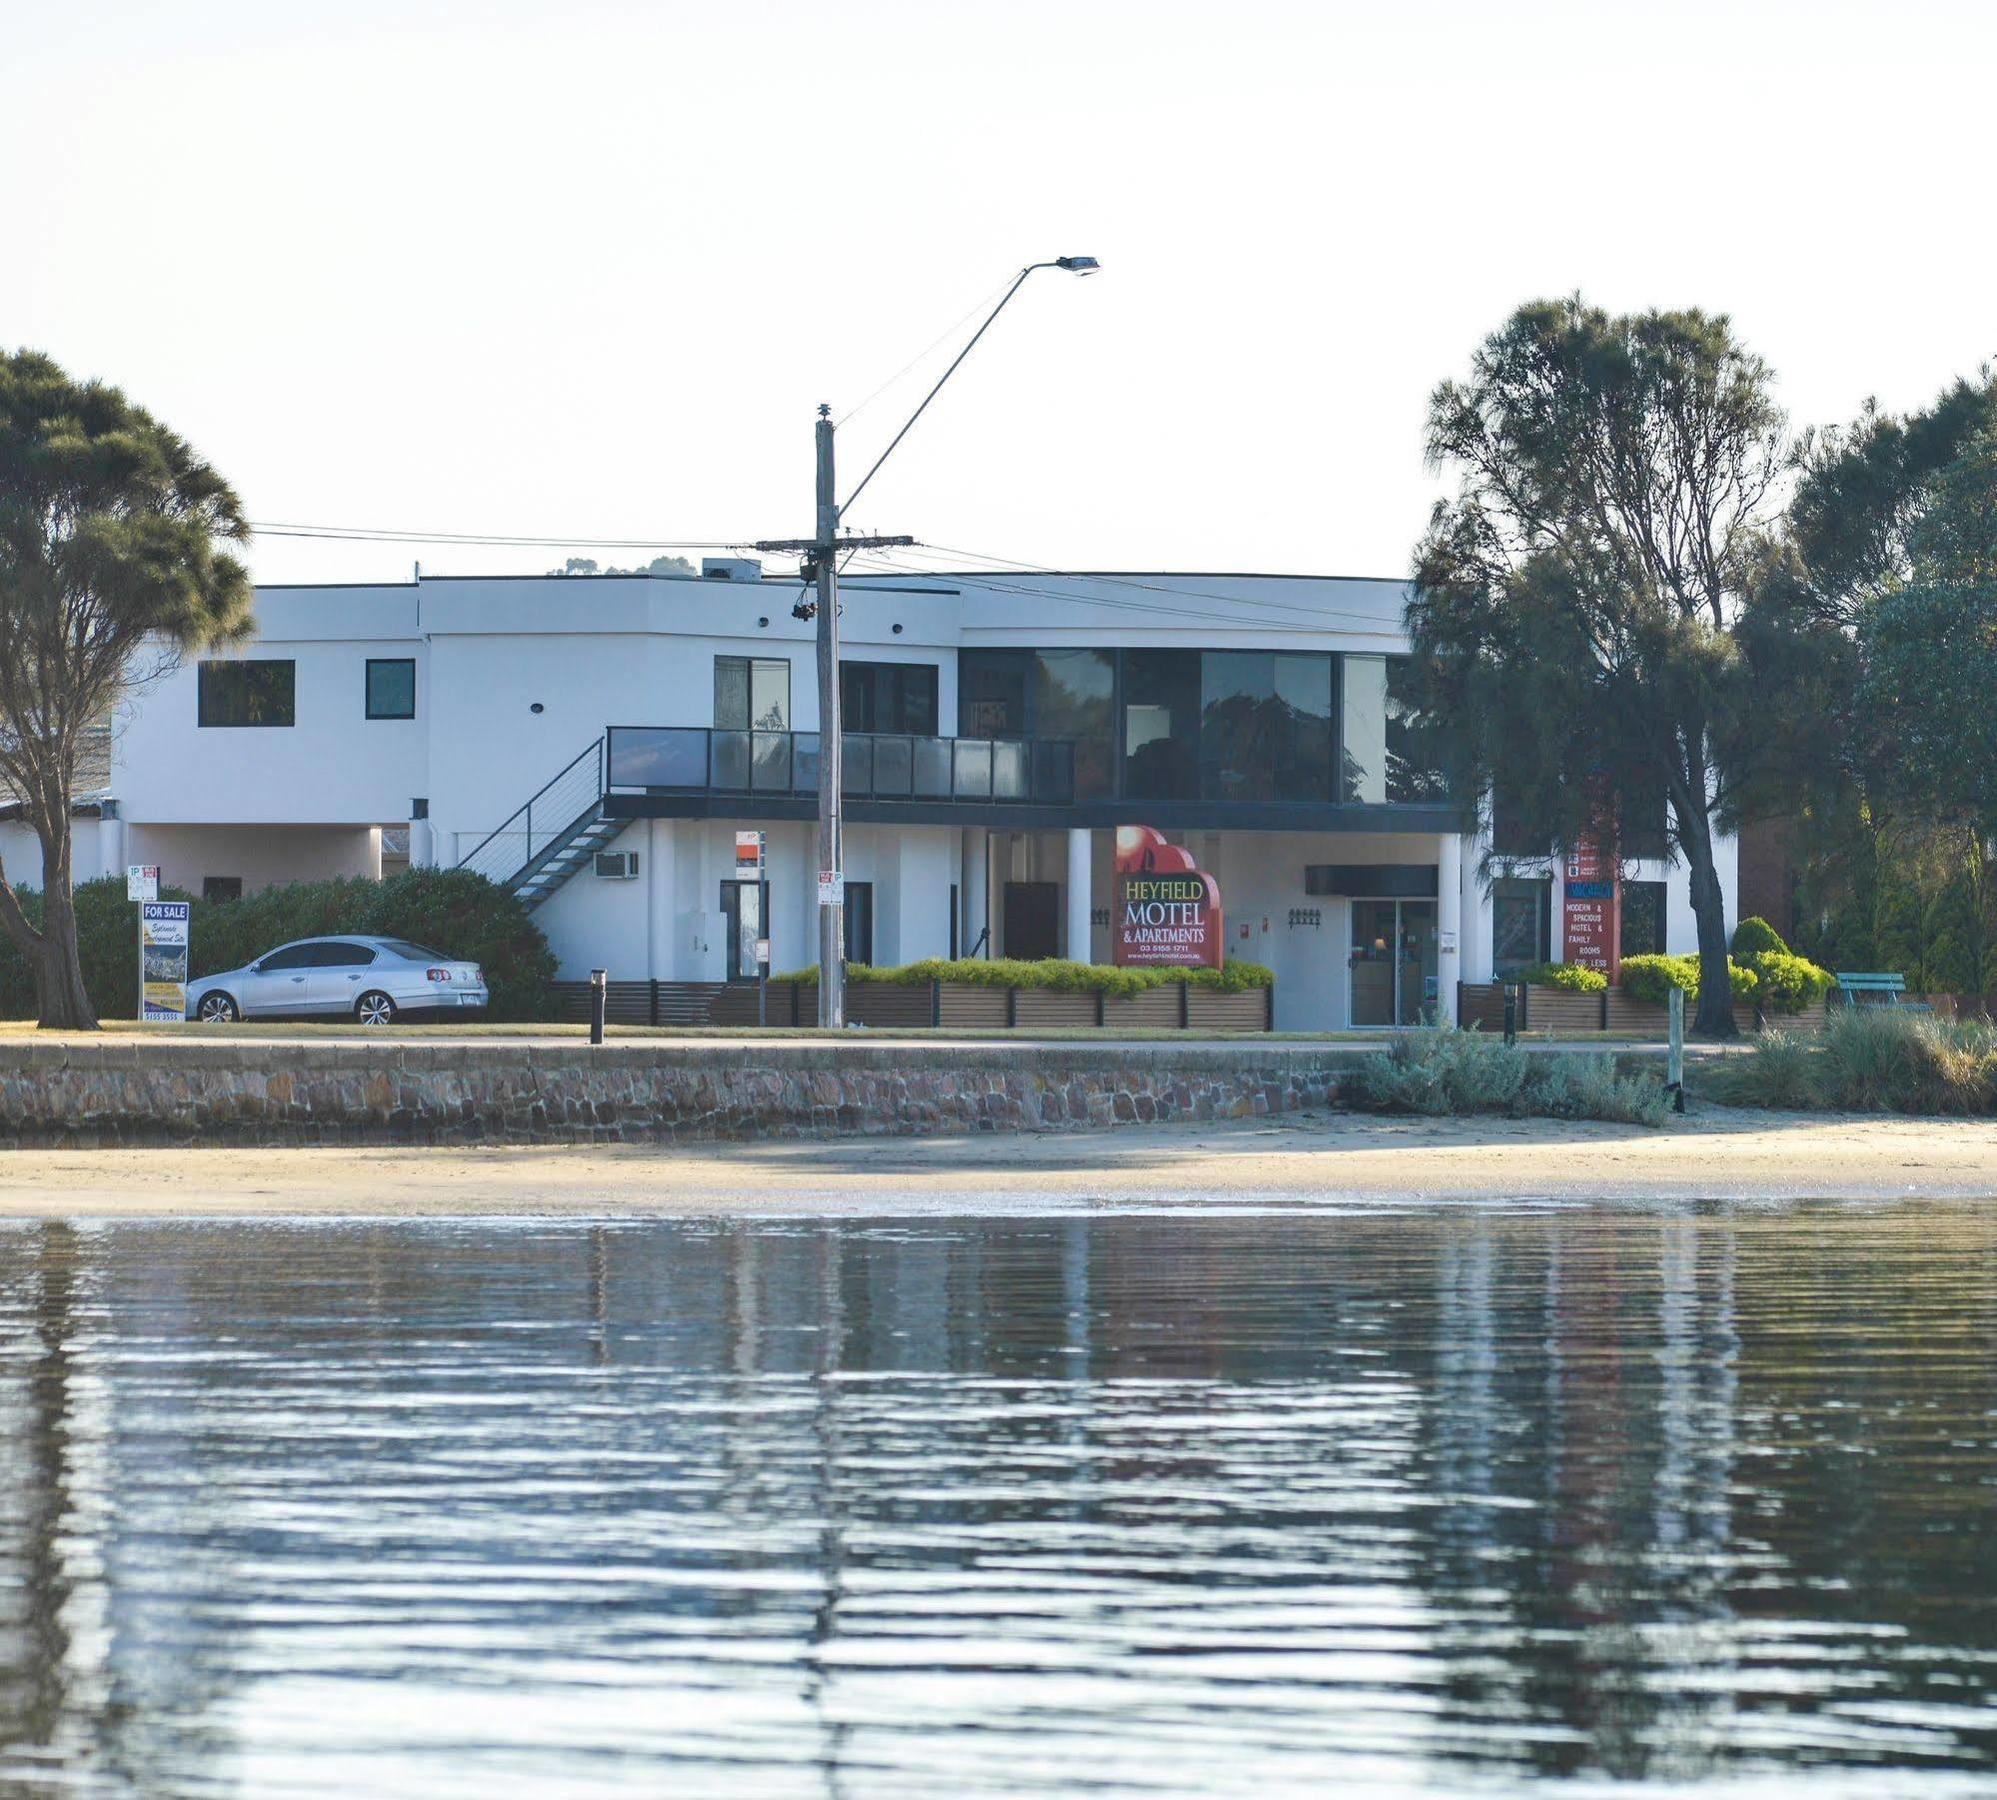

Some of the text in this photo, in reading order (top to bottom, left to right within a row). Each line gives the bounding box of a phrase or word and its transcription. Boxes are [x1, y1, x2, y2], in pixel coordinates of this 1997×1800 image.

[1126, 881, 1203, 899] HEYFIELD
[145, 906, 185, 918] FOR SALE
[1566, 903, 1591, 912] MODERN
[1125, 902, 1205, 926] MOTEL
[1572, 914, 1602, 922] SPACIOUS
[1123, 928, 1205, 943] & APARTMENTS
[1568, 935, 1591, 943] FAMILY
[1579, 947, 1601, 955] ROOMS
[1574, 958, 1607, 967] FOR LESS
